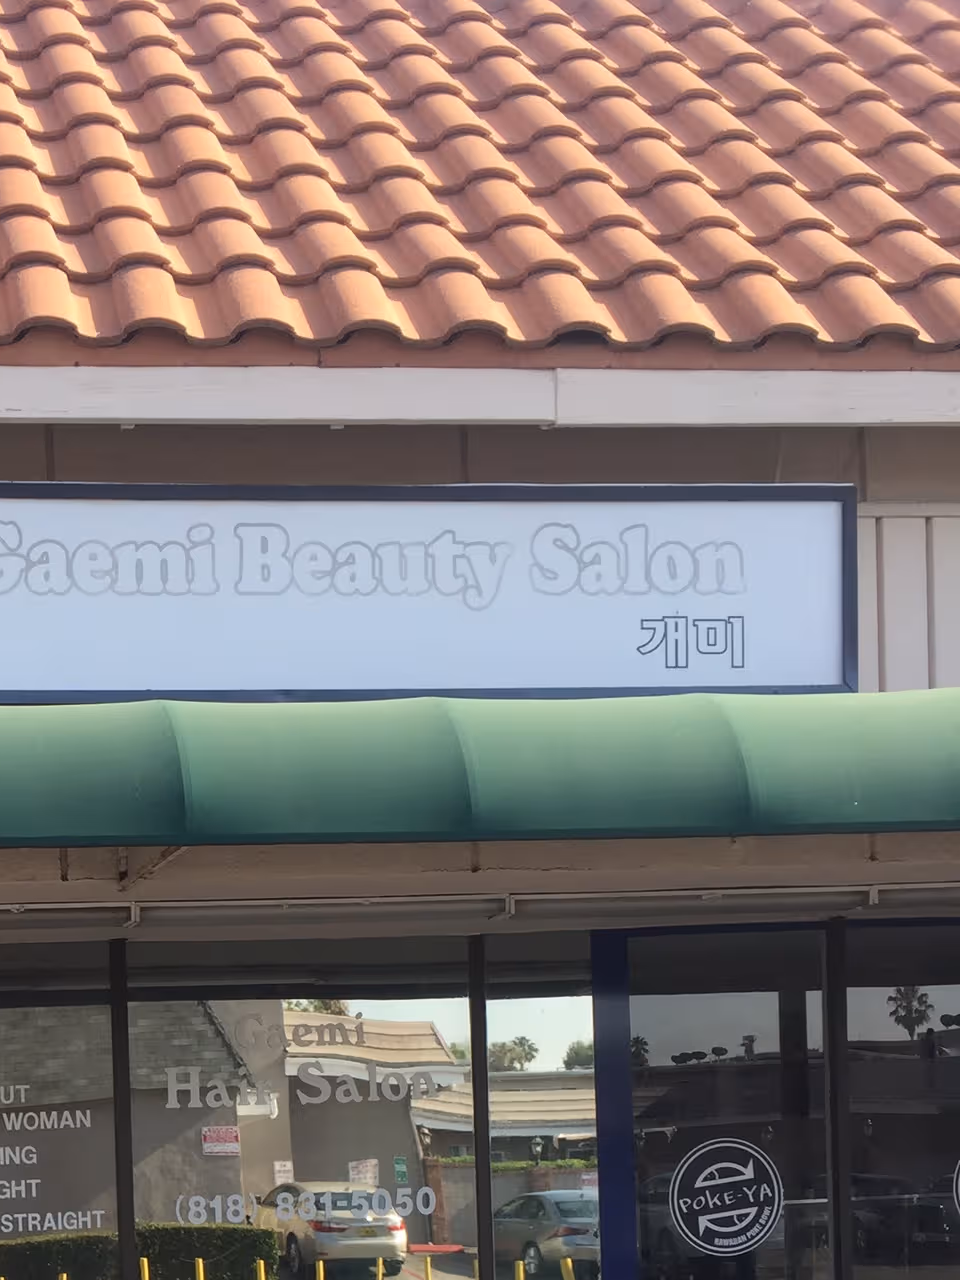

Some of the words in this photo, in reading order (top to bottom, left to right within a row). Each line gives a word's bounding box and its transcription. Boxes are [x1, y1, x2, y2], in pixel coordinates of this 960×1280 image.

[234, 522, 514, 611] Beauty
[529, 522, 747, 596] Salon
[637, 615, 745, 669] 개미
[234, 1012, 366, 1049] Gaemi
[164, 1065, 273, 1108] Hair
[297, 1060, 439, 1105] Salon
[2, 1109, 91, 1131] WOMAN
[175, 1192, 257, 1225] (818)
[276, 1186, 436, 1221] 831-5050
[679, 1183, 772, 1213] POKE-YA
[1, 1210, 105, 1233] STRAIGHT
